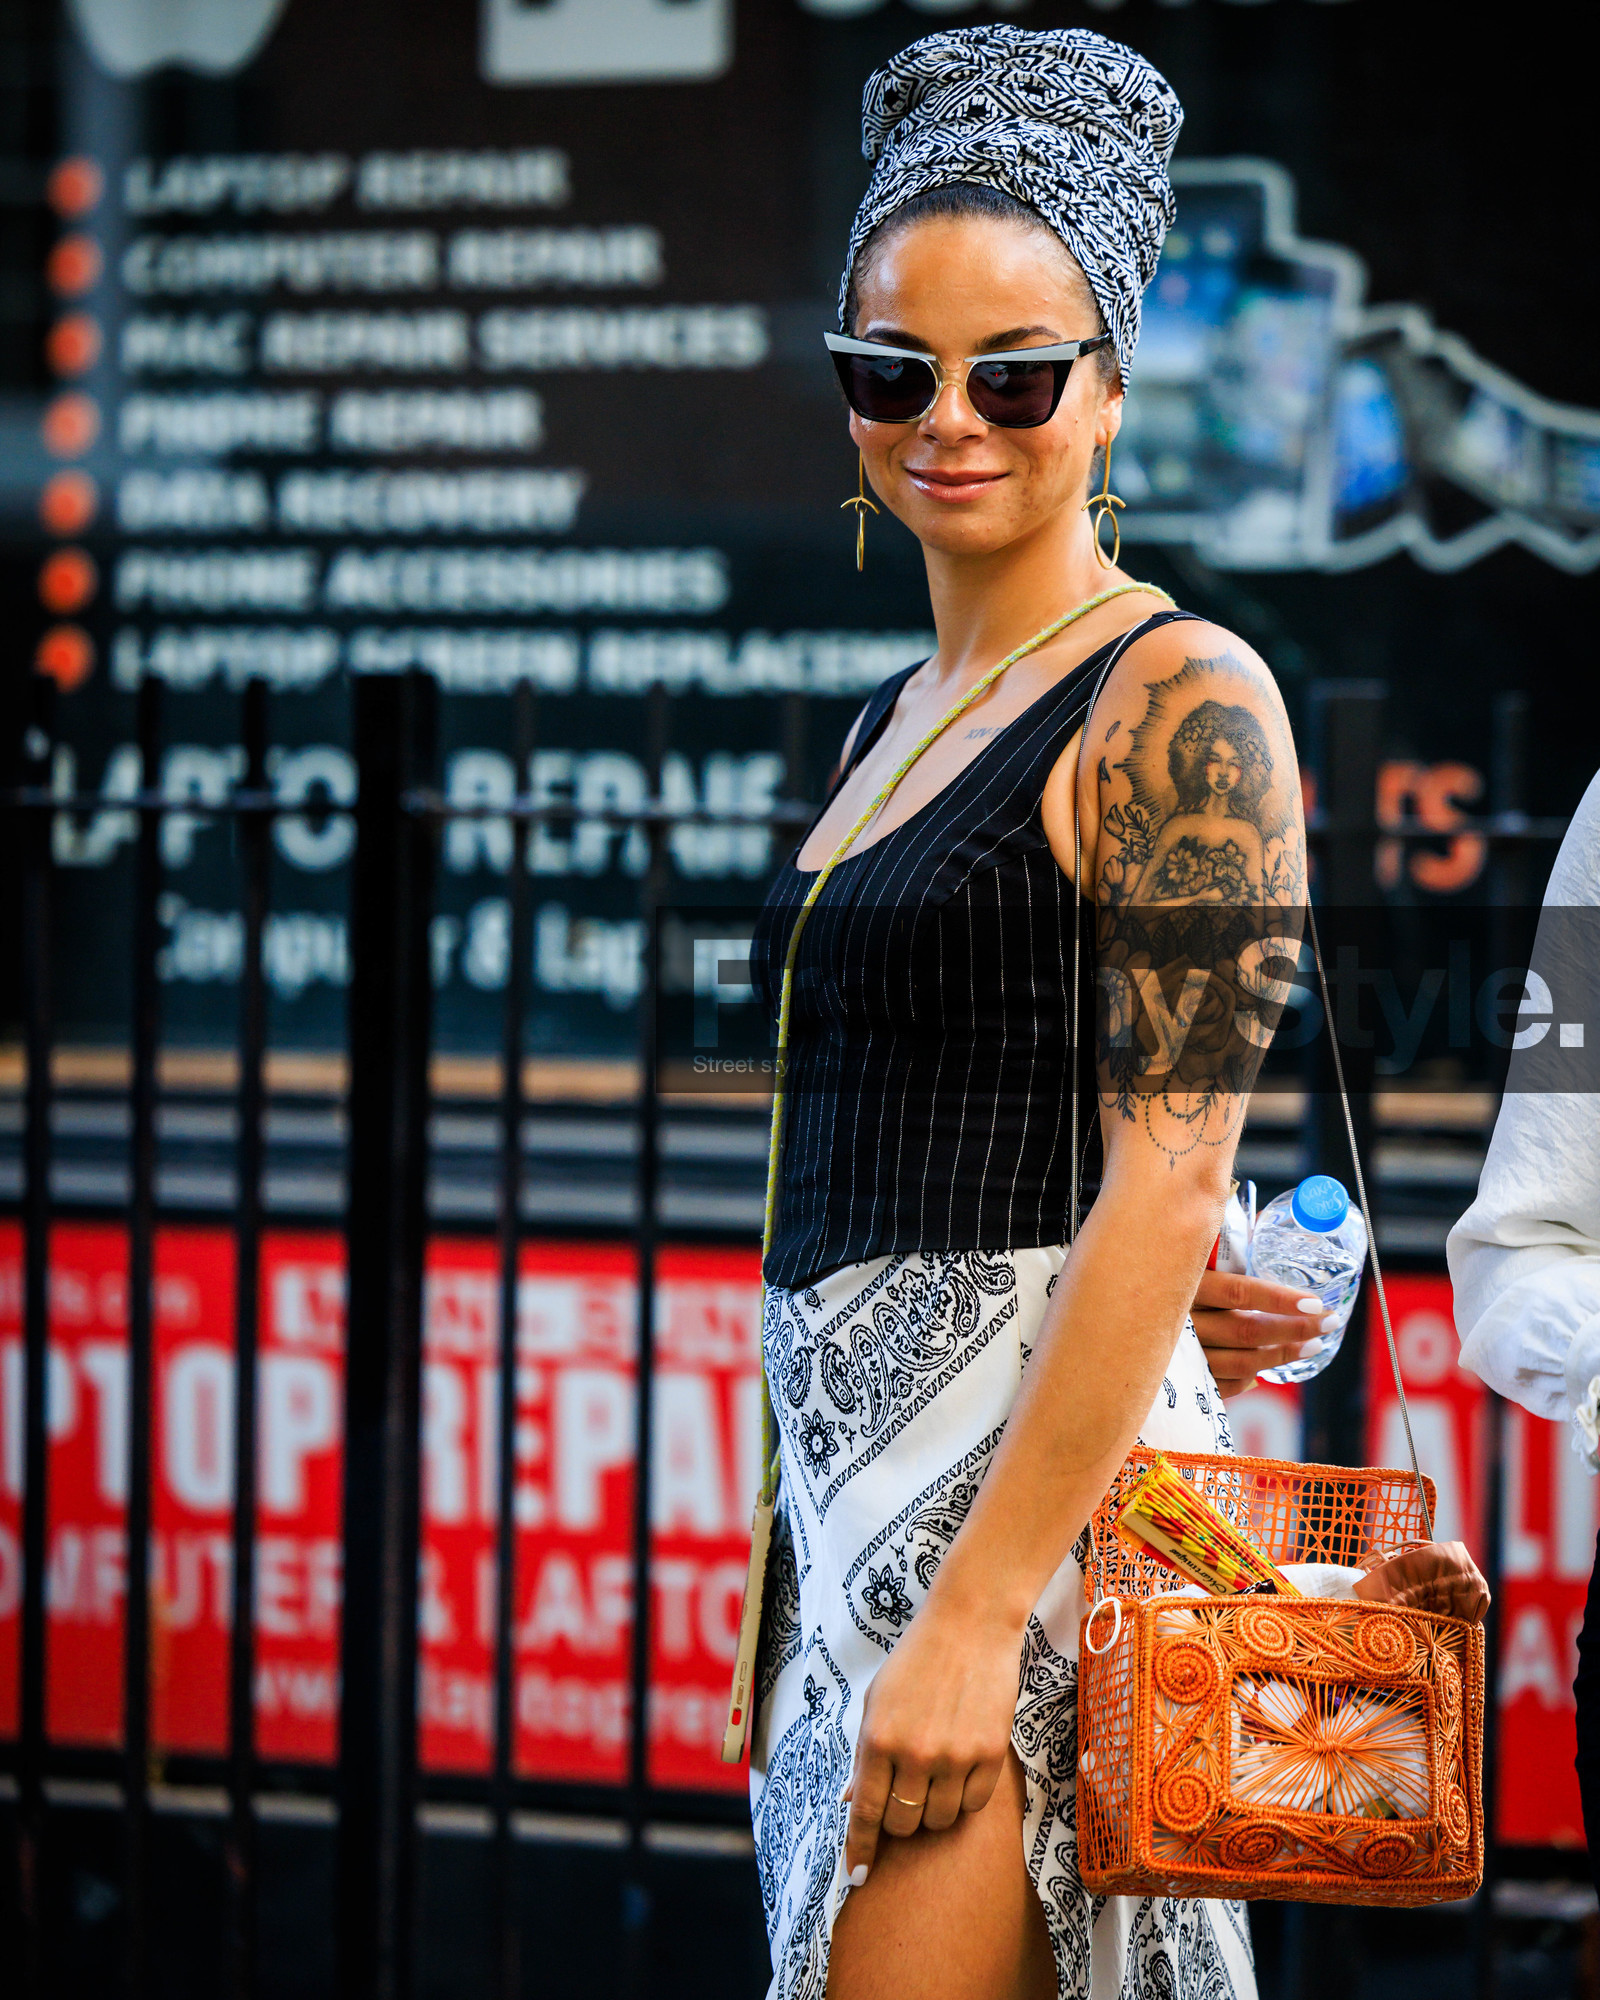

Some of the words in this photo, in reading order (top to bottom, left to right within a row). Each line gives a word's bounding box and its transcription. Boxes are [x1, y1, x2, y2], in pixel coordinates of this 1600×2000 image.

[121, 159, 345, 210] LAPTOP
[357, 151, 567, 208] REPAIR
[118, 234, 438, 292] COMPUTER
[447, 227, 661, 288] REPAIR
[261, 310, 470, 371] REPAIR
[477, 305, 769, 369] SERVICES
[118, 392, 317, 455] PHONE
[329, 388, 541, 452] REPAIR
[276, 469, 584, 533] RECOVERY
[115, 550, 314, 613] PHONE
[324, 548, 728, 612] ACCESSORIES
[1168, 1548, 1228, 1594] Martinique
